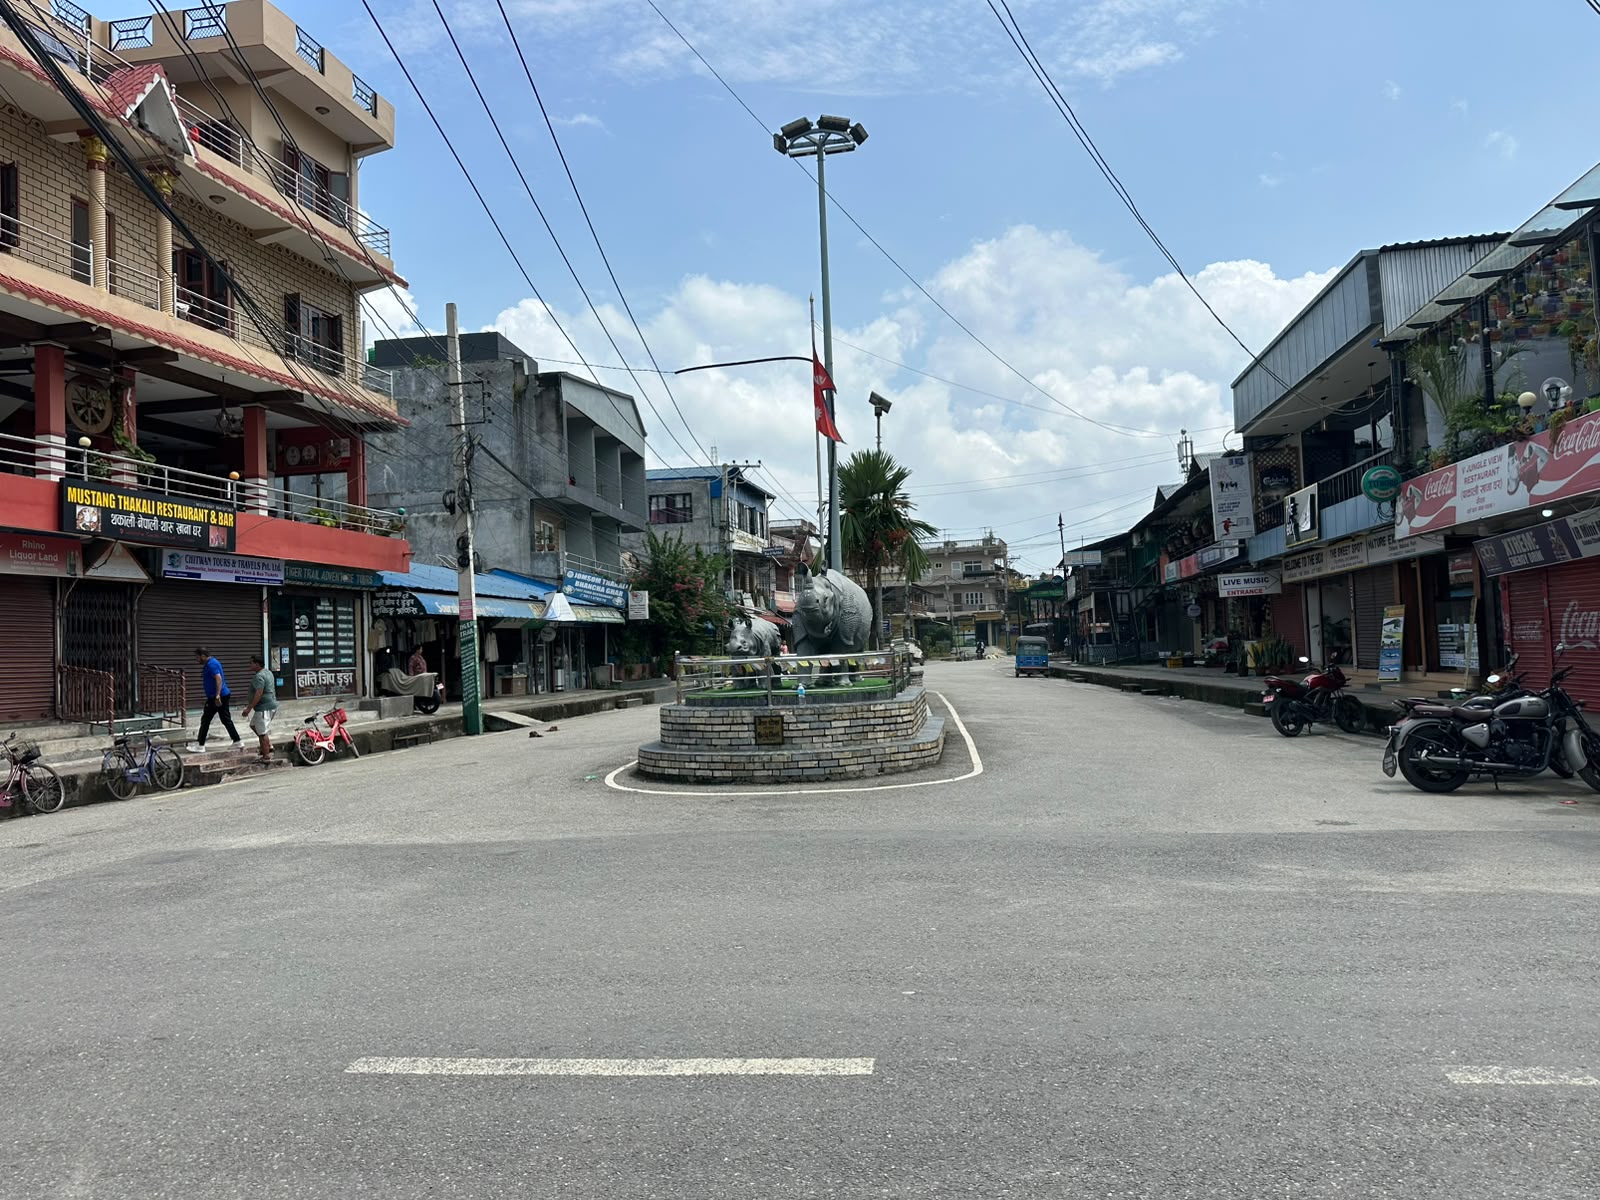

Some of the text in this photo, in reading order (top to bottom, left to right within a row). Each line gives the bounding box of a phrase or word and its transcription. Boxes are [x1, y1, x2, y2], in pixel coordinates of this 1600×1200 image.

[1466, 459, 1487, 474] JUNGLE
[1487, 453, 1503, 465] VIEW
[1463, 466, 1500, 484] RESTAURANT
[67, 486, 116, 509] MUSTANG
[117, 494, 155, 515] THAKALI
[157, 501, 209, 525] RESTAURANT
[209, 512, 217, 525] &
[218, 511, 234, 527] BAR
[176, 522, 192, 536] खाना
[22, 539, 46, 550] Rhino
[1351, 542, 1363, 555] SPOT
[9, 549, 59, 562] Liquor Land
[185, 554, 212, 566] CHITWAN
[213, 557, 231, 568] TOURS
[231, 559, 237, 568] &
[238, 560, 261, 571] TRAVELS
[207, 567, 234, 575] International
[285, 565, 303, 577] TIGER
[303, 567, 320, 580] TRAIL
[321, 570, 354, 583] ADVENTE
[574, 572, 602, 585] JOMSOM
[1223, 576, 1270, 586] LIVE MUSIC
[574, 580, 624, 598] BHANCHA GHAR
[1226, 588, 1264, 597] ENTRANCE
